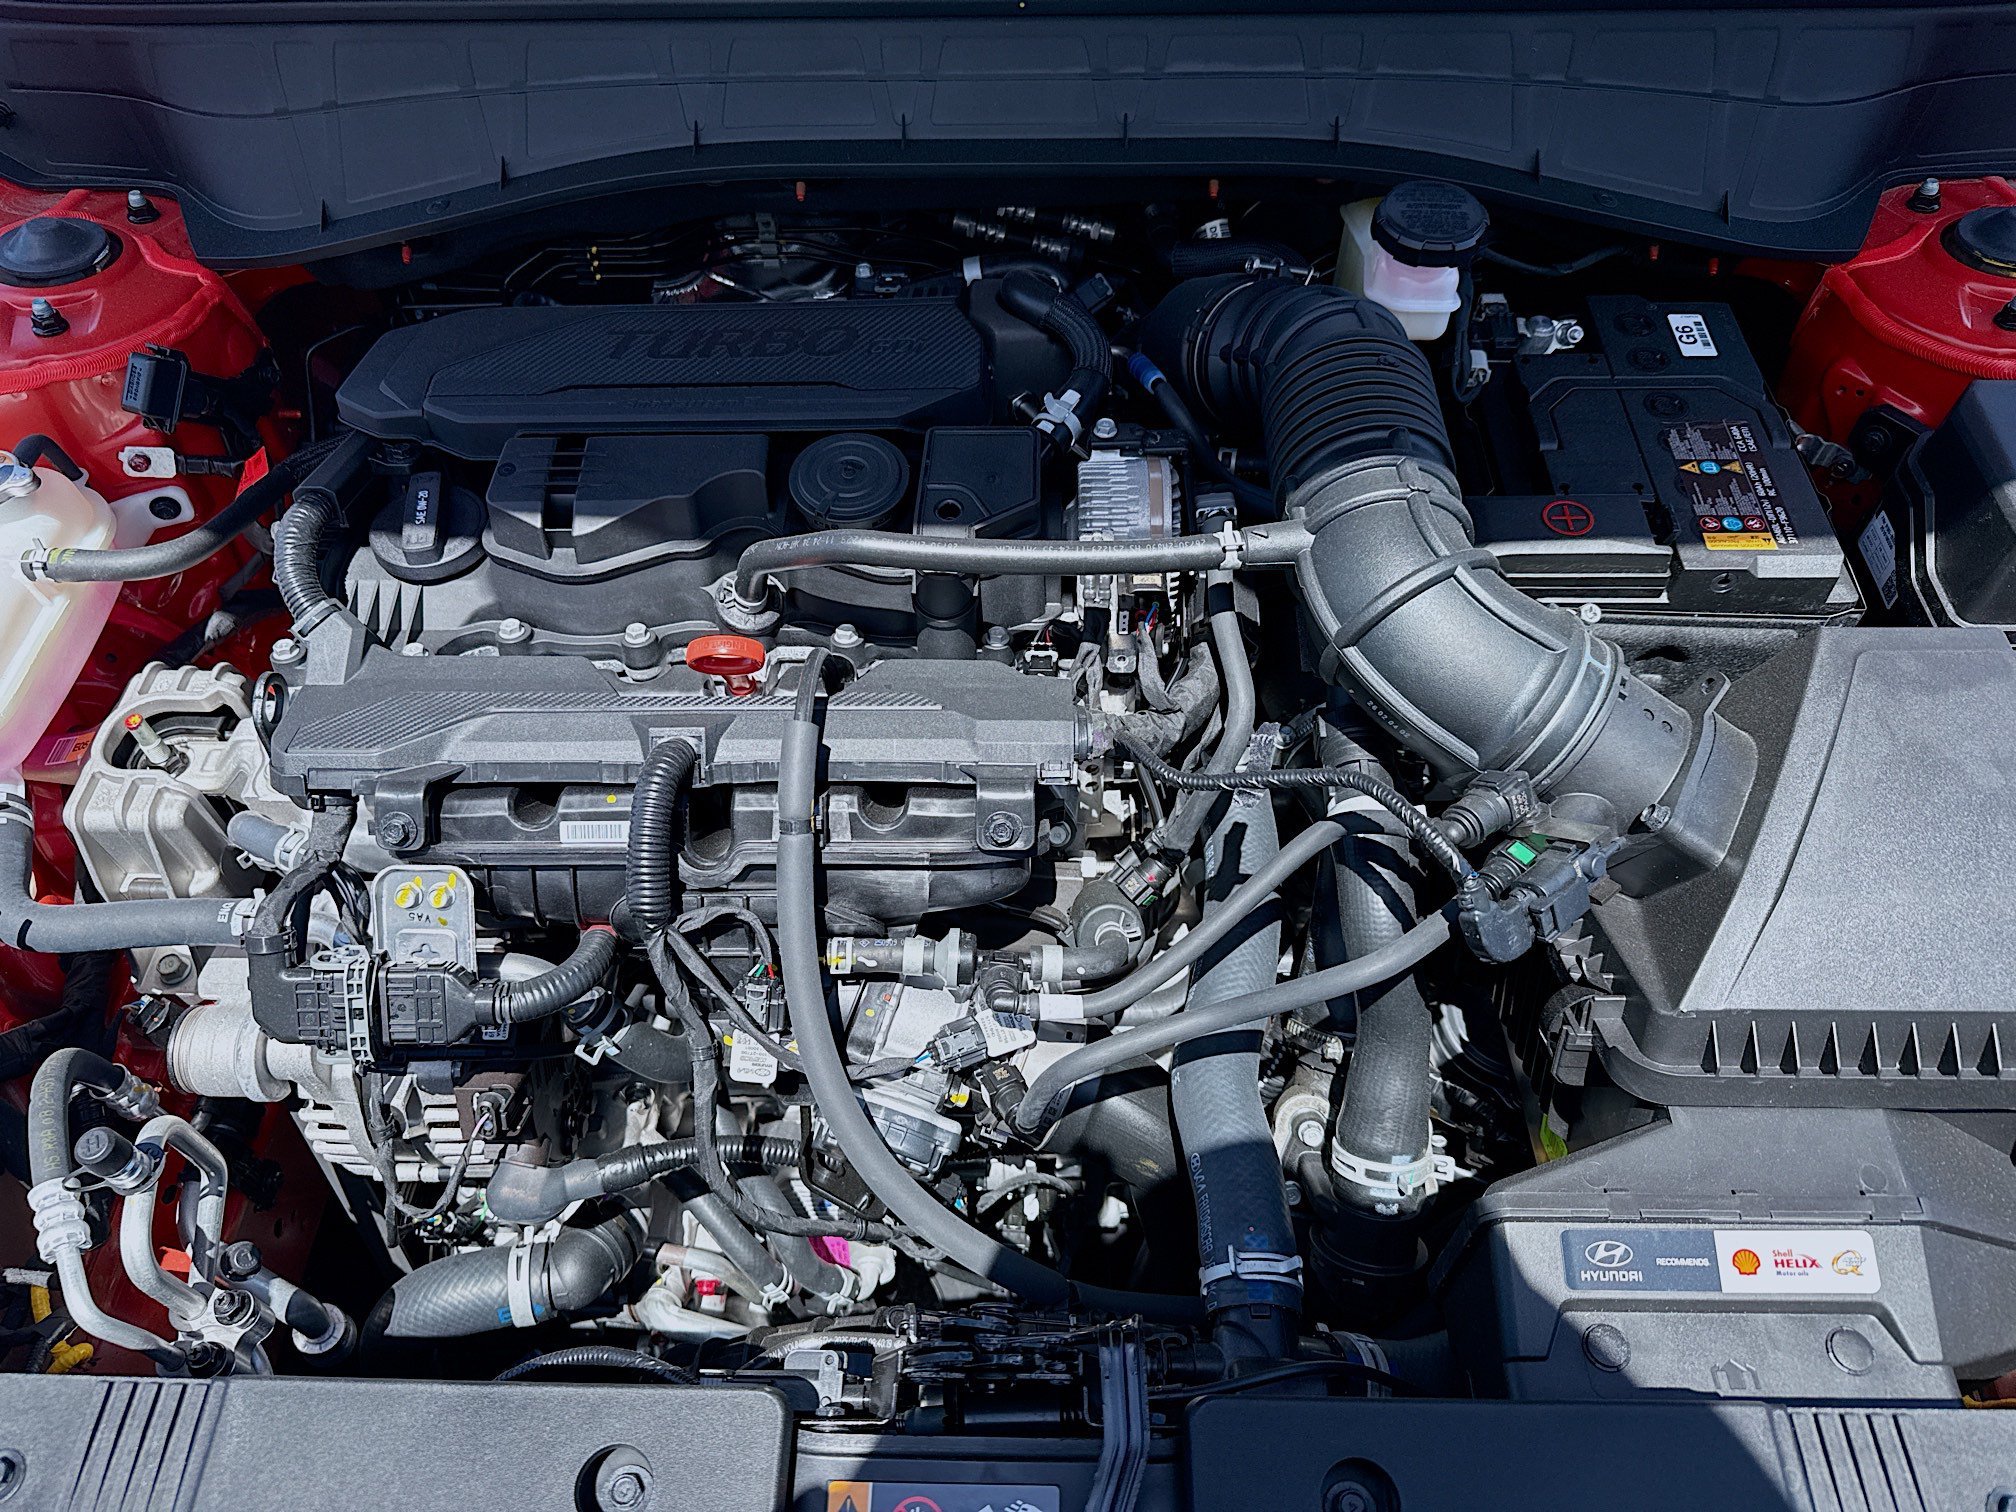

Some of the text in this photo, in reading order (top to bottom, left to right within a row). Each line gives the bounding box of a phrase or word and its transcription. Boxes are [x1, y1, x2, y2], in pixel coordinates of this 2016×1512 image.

[1679, 324, 1695, 347] G6
[606, 325, 860, 360] TURBO
[1735, 440, 1748, 453] CCA
[1765, 488, 1778, 497] RC
[415, 490, 429, 525] SAE 0W-20
[1772, 1249, 1794, 1258] Shell
[1656, 1257, 1710, 1267] RECOMMENDS
[1773, 1259, 1821, 1270] HELIX
[1580, 1270, 1643, 1282] HYUNDAI
